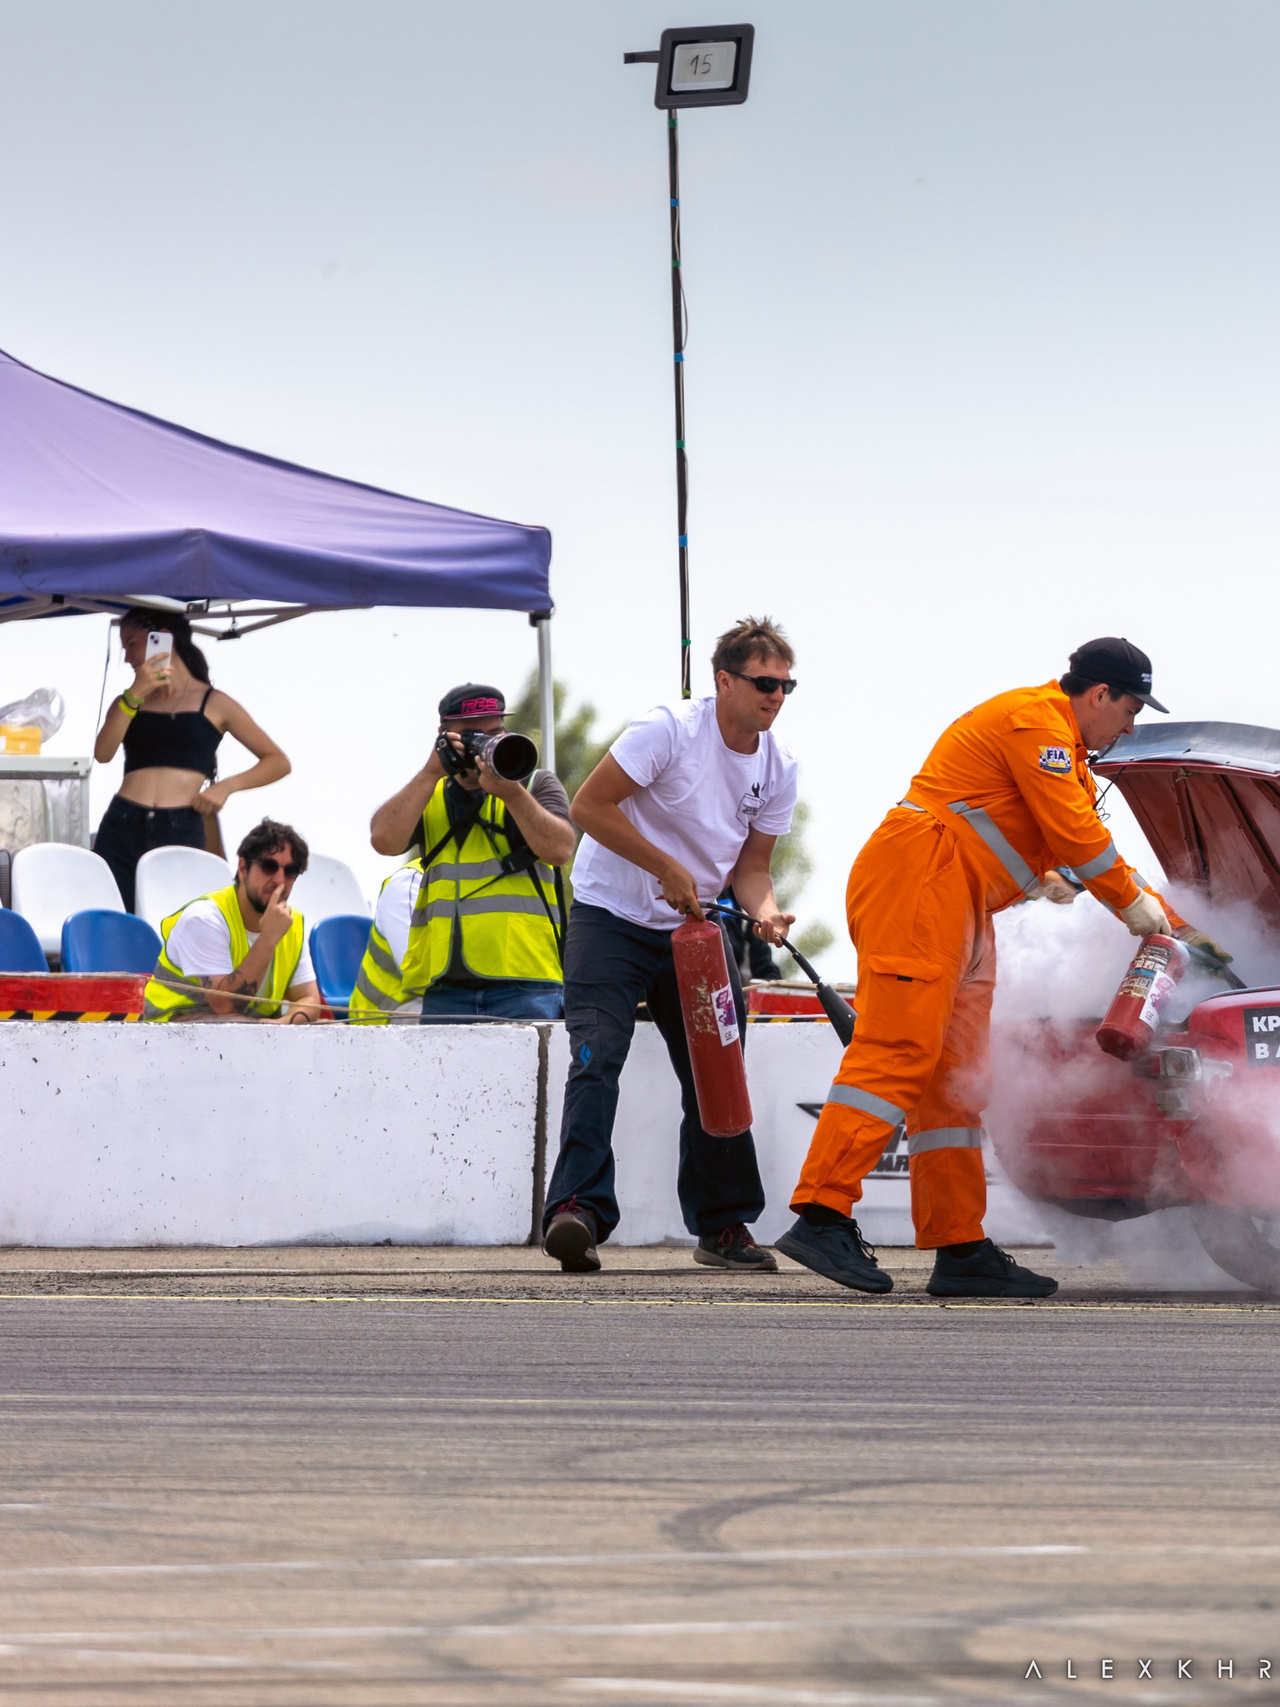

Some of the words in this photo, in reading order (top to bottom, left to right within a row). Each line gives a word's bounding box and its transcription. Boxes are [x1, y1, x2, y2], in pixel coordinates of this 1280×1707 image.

[689, 53, 714, 75] 15
[1046, 749, 1066, 761] FIA
[1255, 1043, 1270, 1059] В
